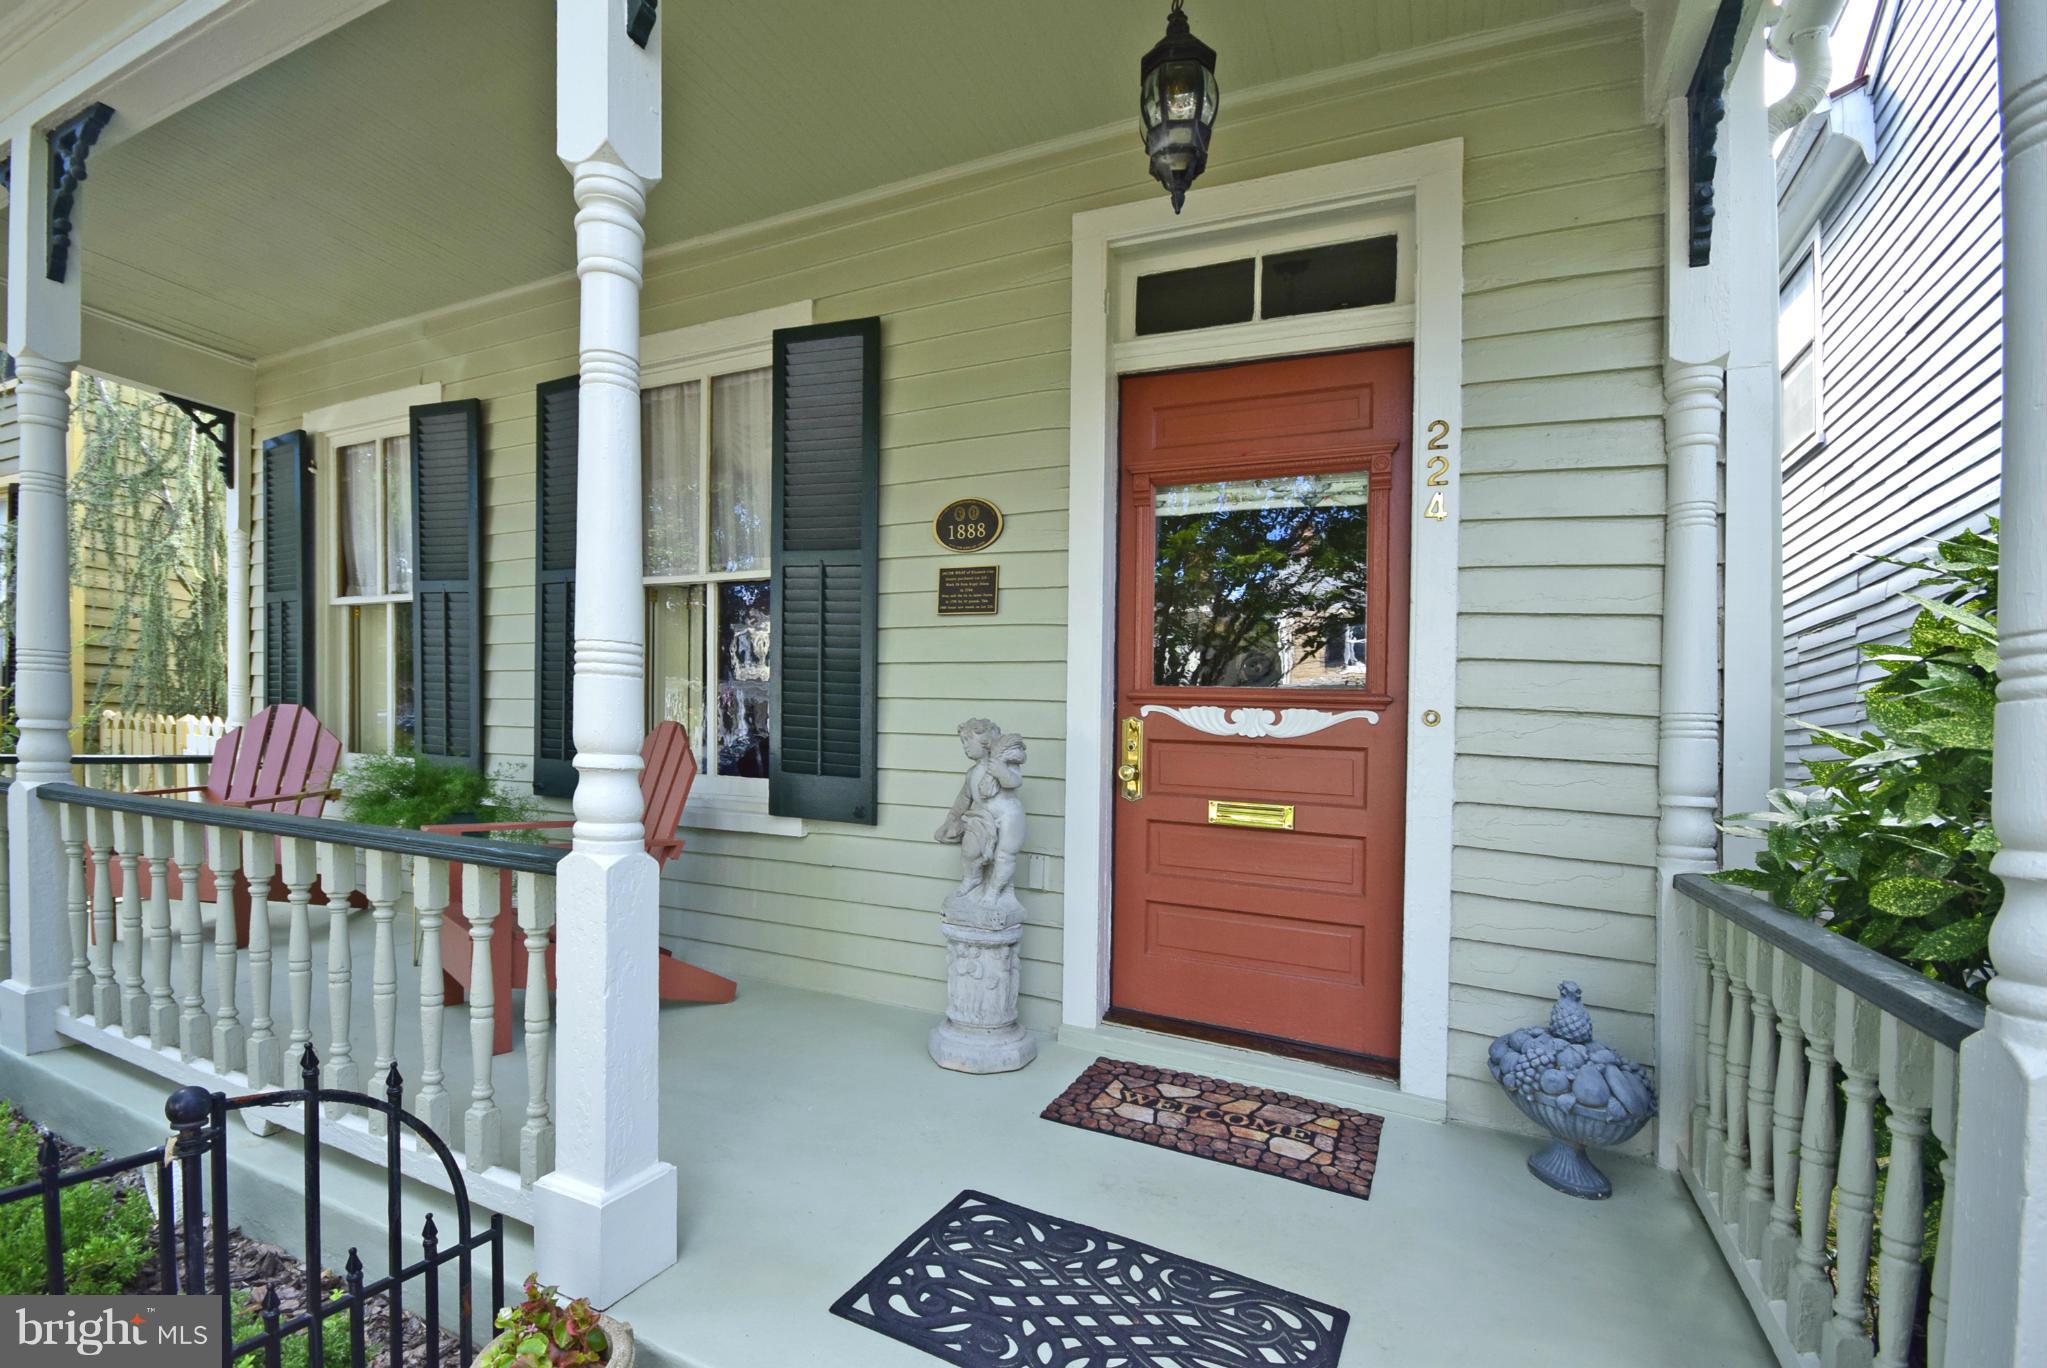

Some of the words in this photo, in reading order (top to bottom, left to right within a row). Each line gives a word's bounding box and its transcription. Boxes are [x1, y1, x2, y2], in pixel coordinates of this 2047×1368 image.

[1424, 419, 1450, 521] 224
[948, 522, 986, 540] 1888
[1122, 1089, 1312, 1143] WELCOME
